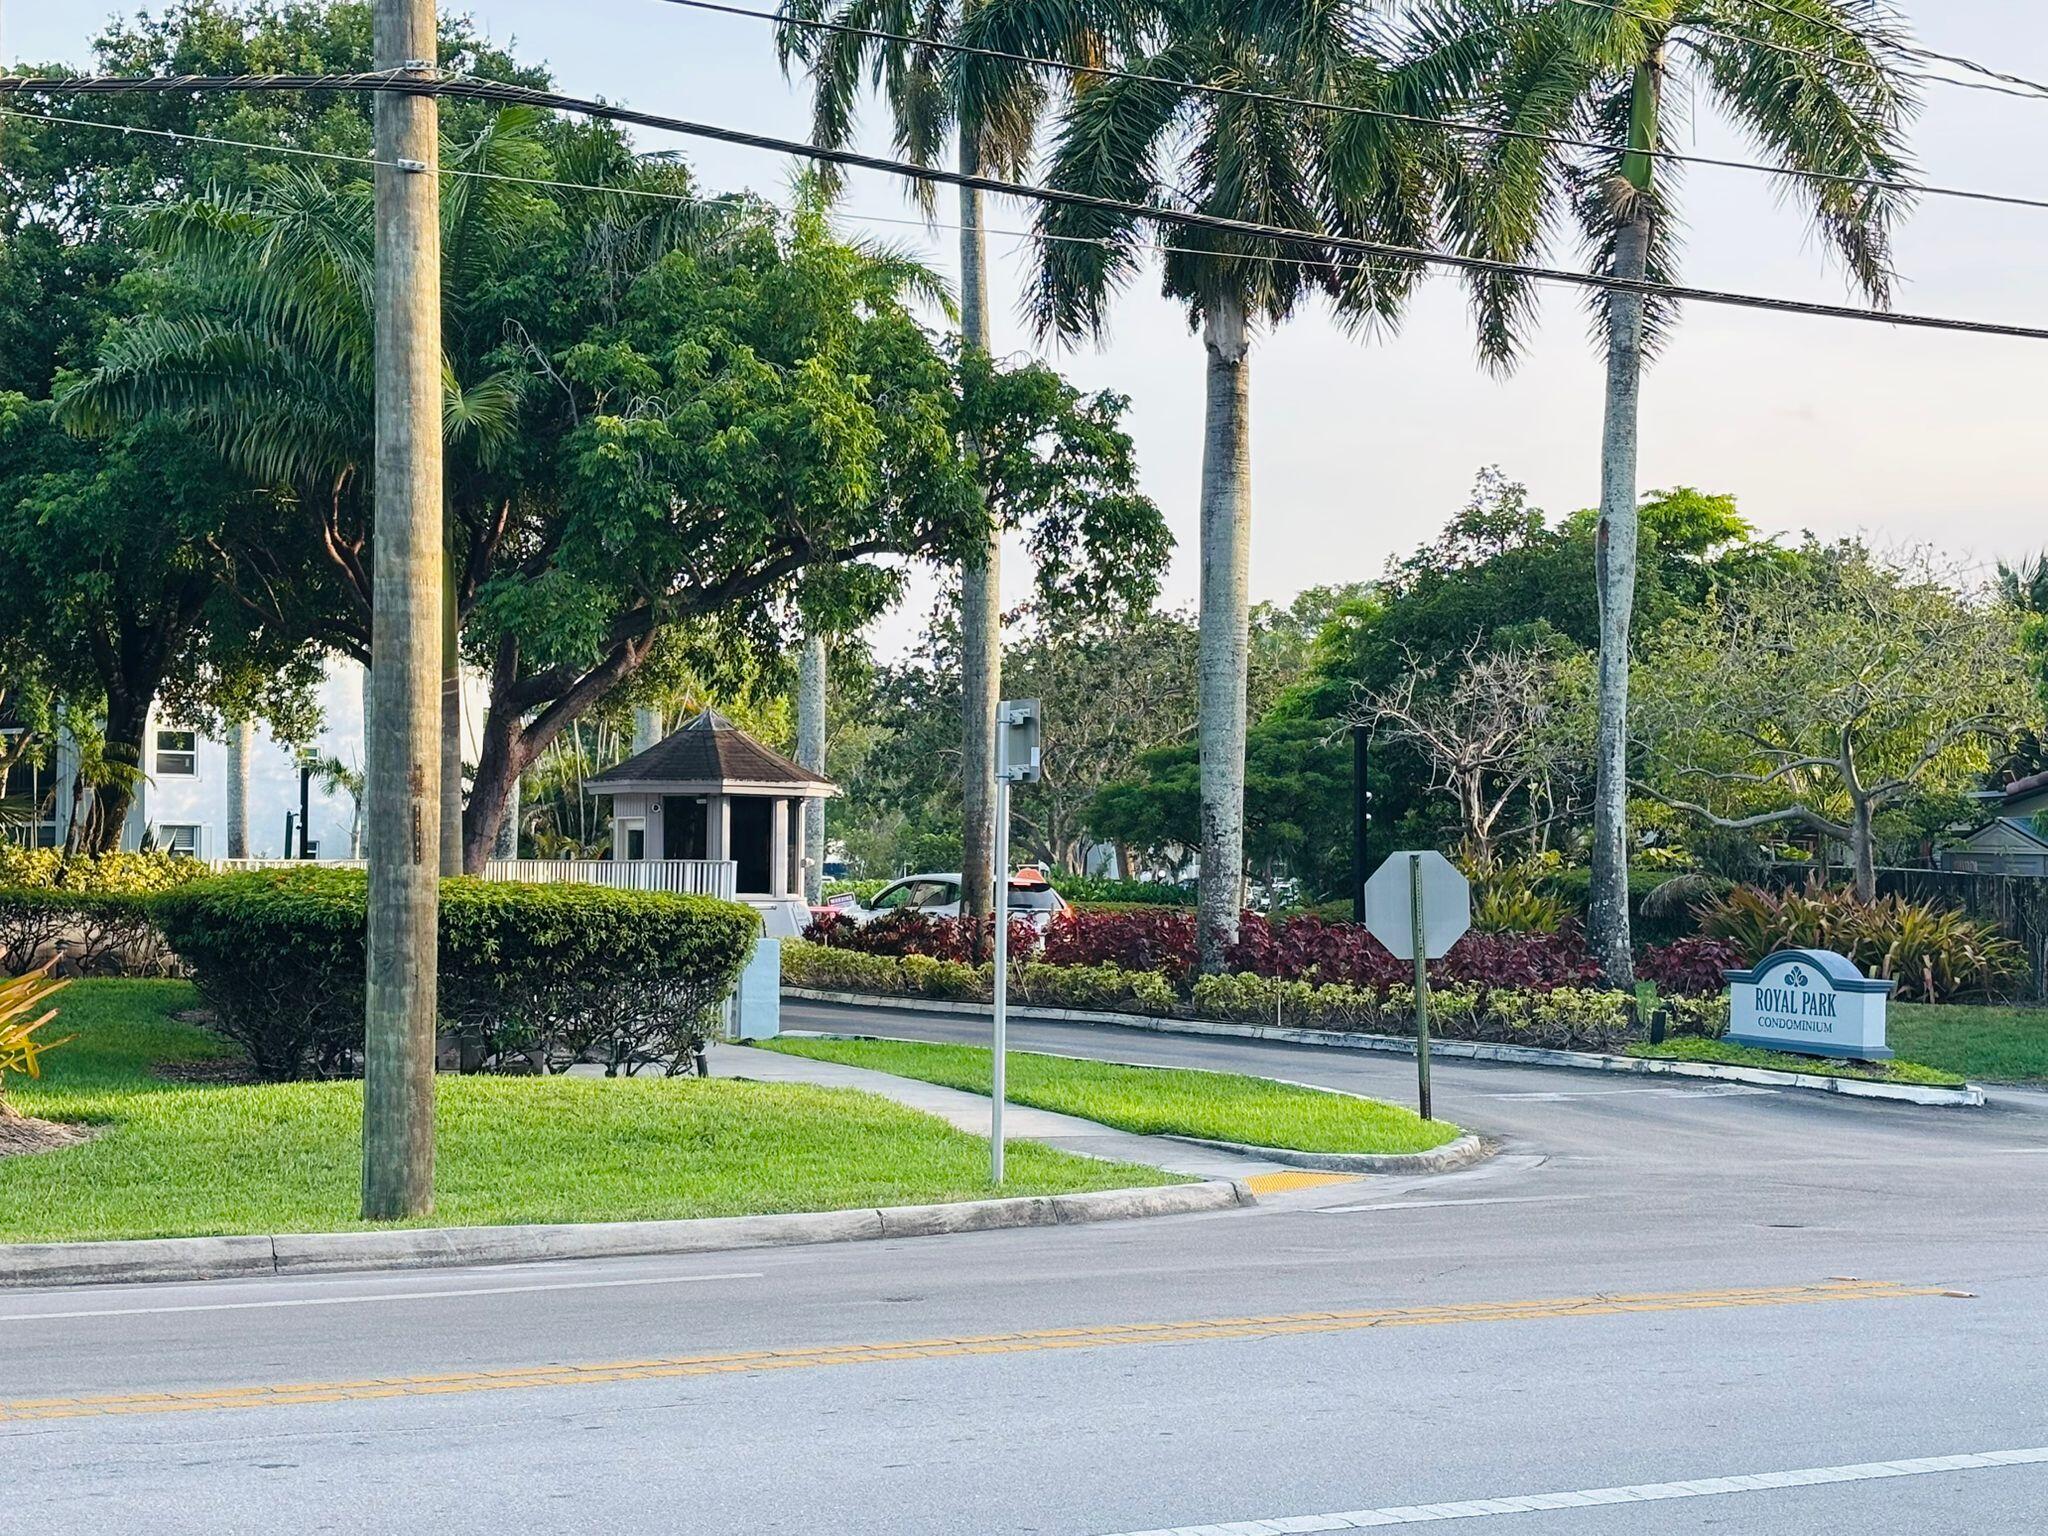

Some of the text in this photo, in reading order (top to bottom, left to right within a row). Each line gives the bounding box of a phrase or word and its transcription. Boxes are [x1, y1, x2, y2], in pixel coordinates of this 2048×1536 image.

[1755, 987, 1837, 1017] ROYAL PARK
[1757, 1016, 1833, 1033] CONDOMINIUM
